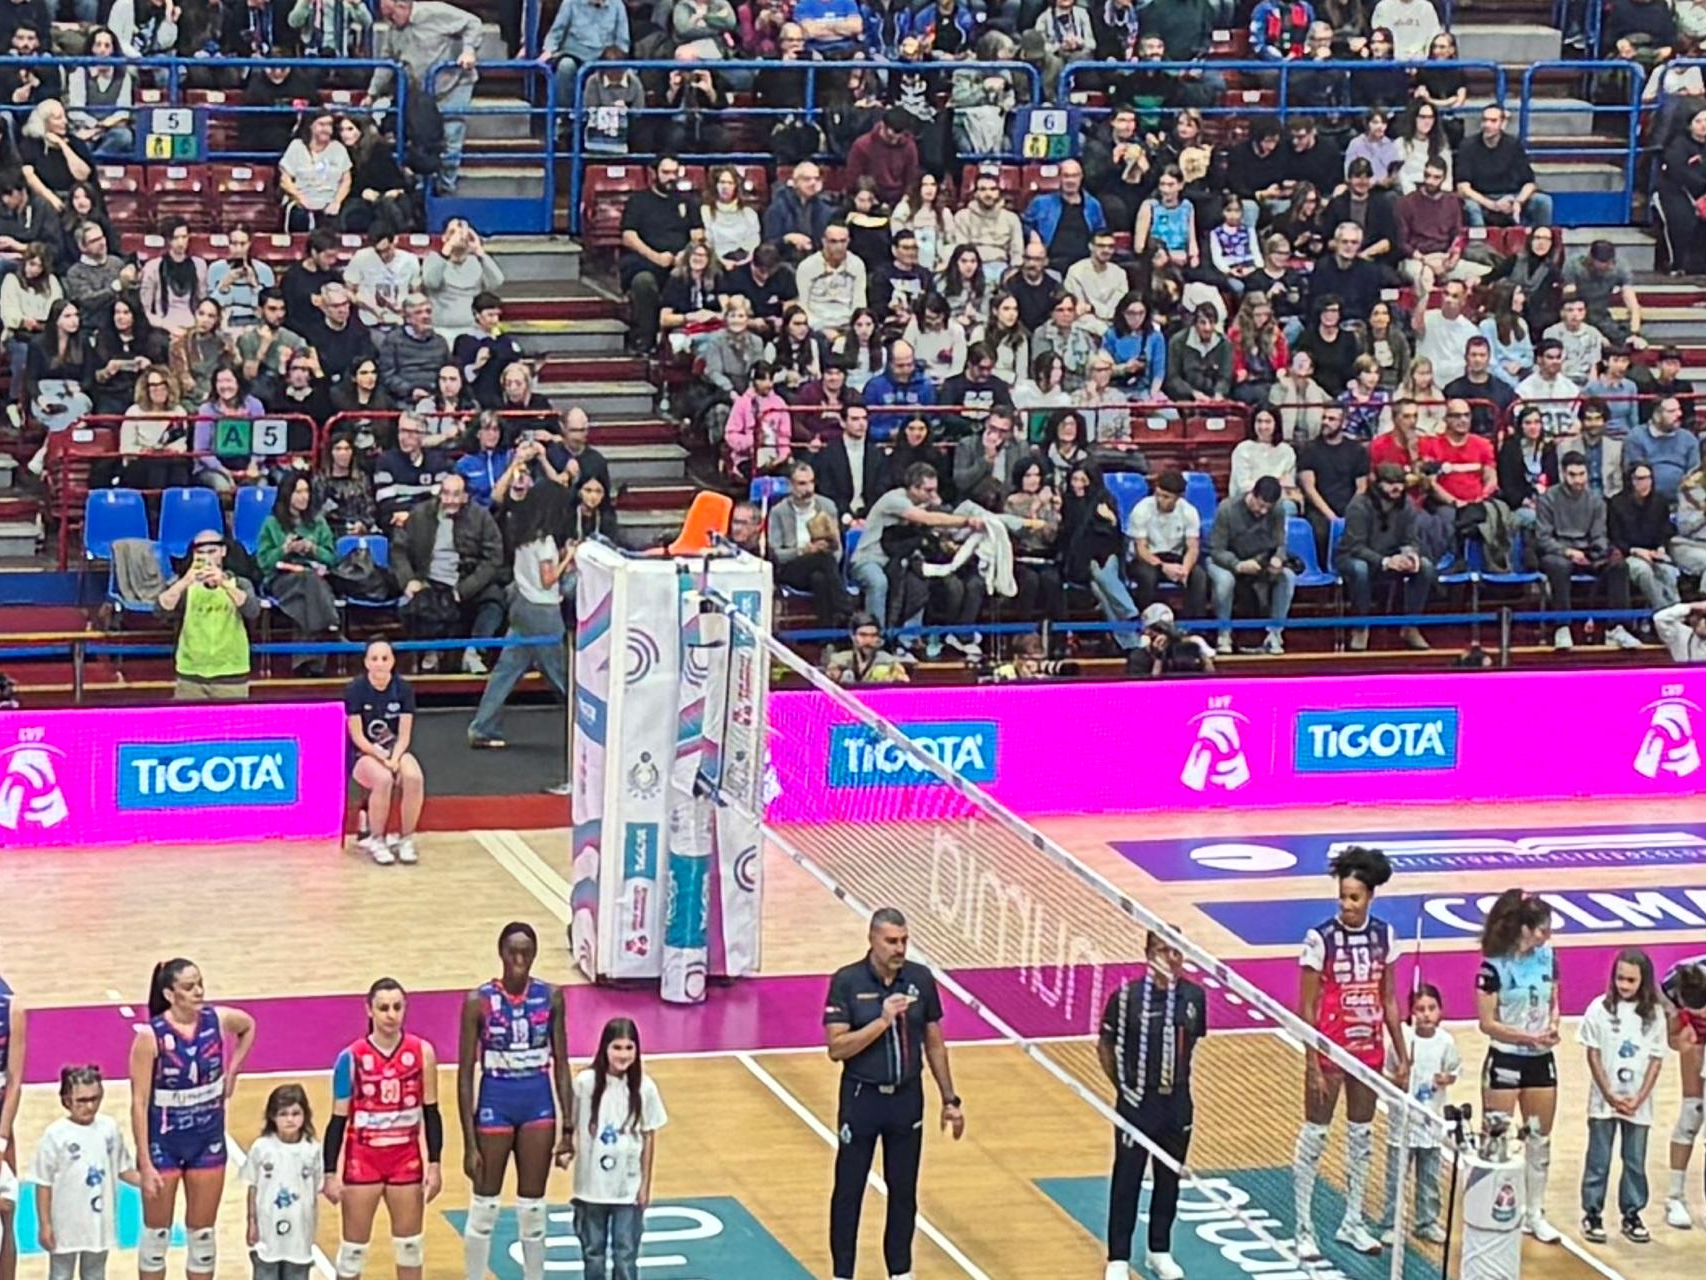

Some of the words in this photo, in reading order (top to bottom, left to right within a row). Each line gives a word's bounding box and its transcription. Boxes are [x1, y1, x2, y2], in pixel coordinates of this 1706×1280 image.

[168, 112, 180, 130] 5
[1043, 113, 1055, 130] 6
[223, 426, 243, 449] A
[263, 425, 277, 447] 5
[187, 1058, 200, 1085] 4
